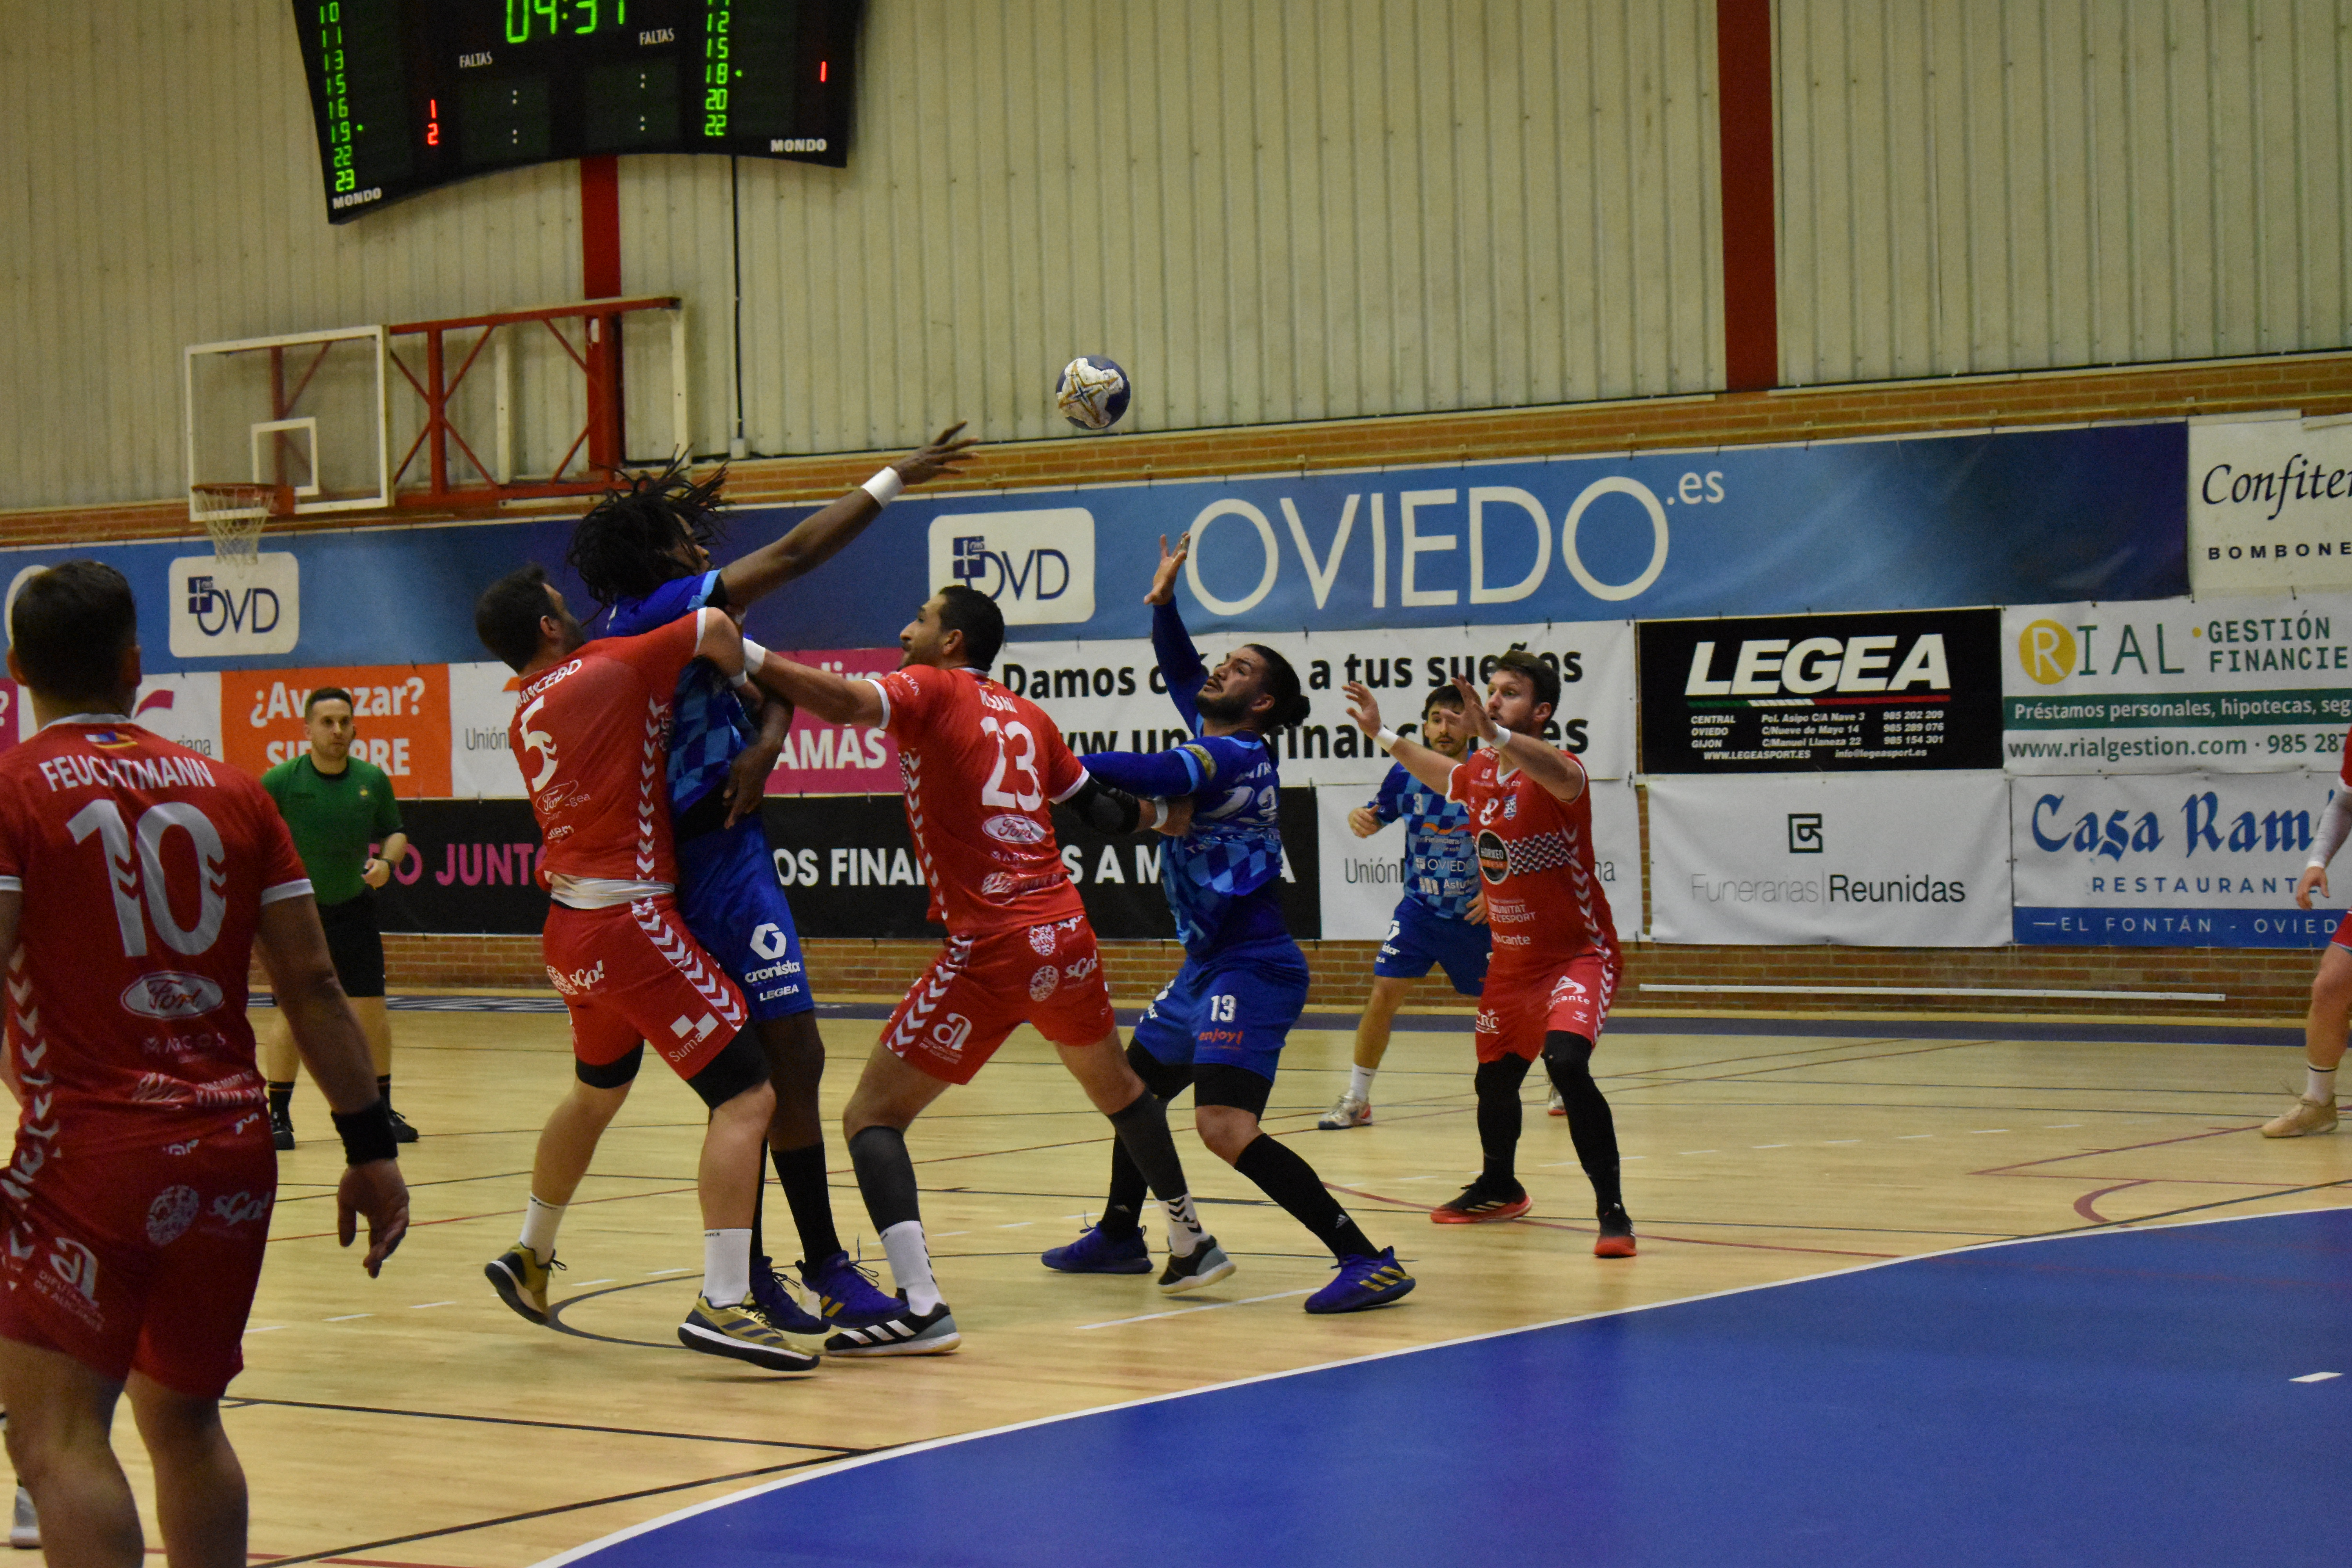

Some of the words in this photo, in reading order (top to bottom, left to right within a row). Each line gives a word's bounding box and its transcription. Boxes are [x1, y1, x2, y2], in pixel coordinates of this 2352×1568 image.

[707, 11, 730, 32] 12
[639, 27, 674, 45] FALTAS
[706, 37, 729, 58] 15
[324, 49, 344, 71] 13
[459, 51, 492, 69] FALTAS
[326, 73, 346, 95] 15
[706, 62, 728, 85] 18
[328, 97, 348, 120] 16
[705, 88, 728, 111] 20
[331, 120, 351, 144] 19
[427, 122, 439, 145] 2
[704, 114, 727, 136] 22
[333, 144, 352, 168] 22
[770, 138, 827, 153] MONDO
[335, 168, 355, 192] 23
[332, 187, 382, 209] MONDO
[2032, 622, 2185, 679] RIAL
[2207, 610, 2330, 644] GESTIÓN
[1004, 663, 1136, 699] Damos
[1309, 660, 1330, 690] a
[1345, 653, 1413, 688] tus
[1427, 642, 1583, 688] sues
[1684, 633, 1951, 696] LEGEA
[249, 677, 426, 728] ¿Avzar?
[2014, 699, 2105, 721] Préstamos
[2110, 699, 2216, 723] personales,
[2221, 697, 2318, 720] hipotecas,
[1690, 715, 1736, 724] CENTRAL
[1858, 712, 1866, 721] 3
[1882, 711, 1902, 720] 985
[1904, 710, 1923, 720] 202
[1691, 727, 1729, 736] OVIEDO
[1804, 725, 1816, 734] de
[1847, 724, 1860, 733] 14
[1883, 723, 1902, 733] 985
[1848, 737, 1862, 746] 22
[1883, 735, 1902, 745] 985
[519, 695, 559, 792] 5
[2008, 736, 2247, 763] www.rialgestion.com
[2267, 733, 2308, 755] 985
[266, 737, 411, 777] SIEPRE
[980, 716, 1044, 812] 23
[39, 754, 216, 792] FEUCHTMANN
[1413, 793, 1424, 815] 3
[997, 818, 1034, 839] Ford
[2031, 793, 2165, 862] Casa
[2180, 789, 2317, 858] Ram
[66, 799, 226, 957] 10
[1691, 873, 1819, 903] Funerarias
[1829, 874, 1966, 903] Reunidas
[2092, 877, 2318, 894] RESTAURANT
[2061, 916, 2090, 932] EL
[2106, 915, 2212, 933] FONTÁN
[745, 960, 800, 983] cronista
[760, 984, 799, 1002] LEGEA
[1210, 995, 1237, 1023] 13
[668, 1031, 704, 1063] Suma
[1198, 1028, 1244, 1045] enjoy!
